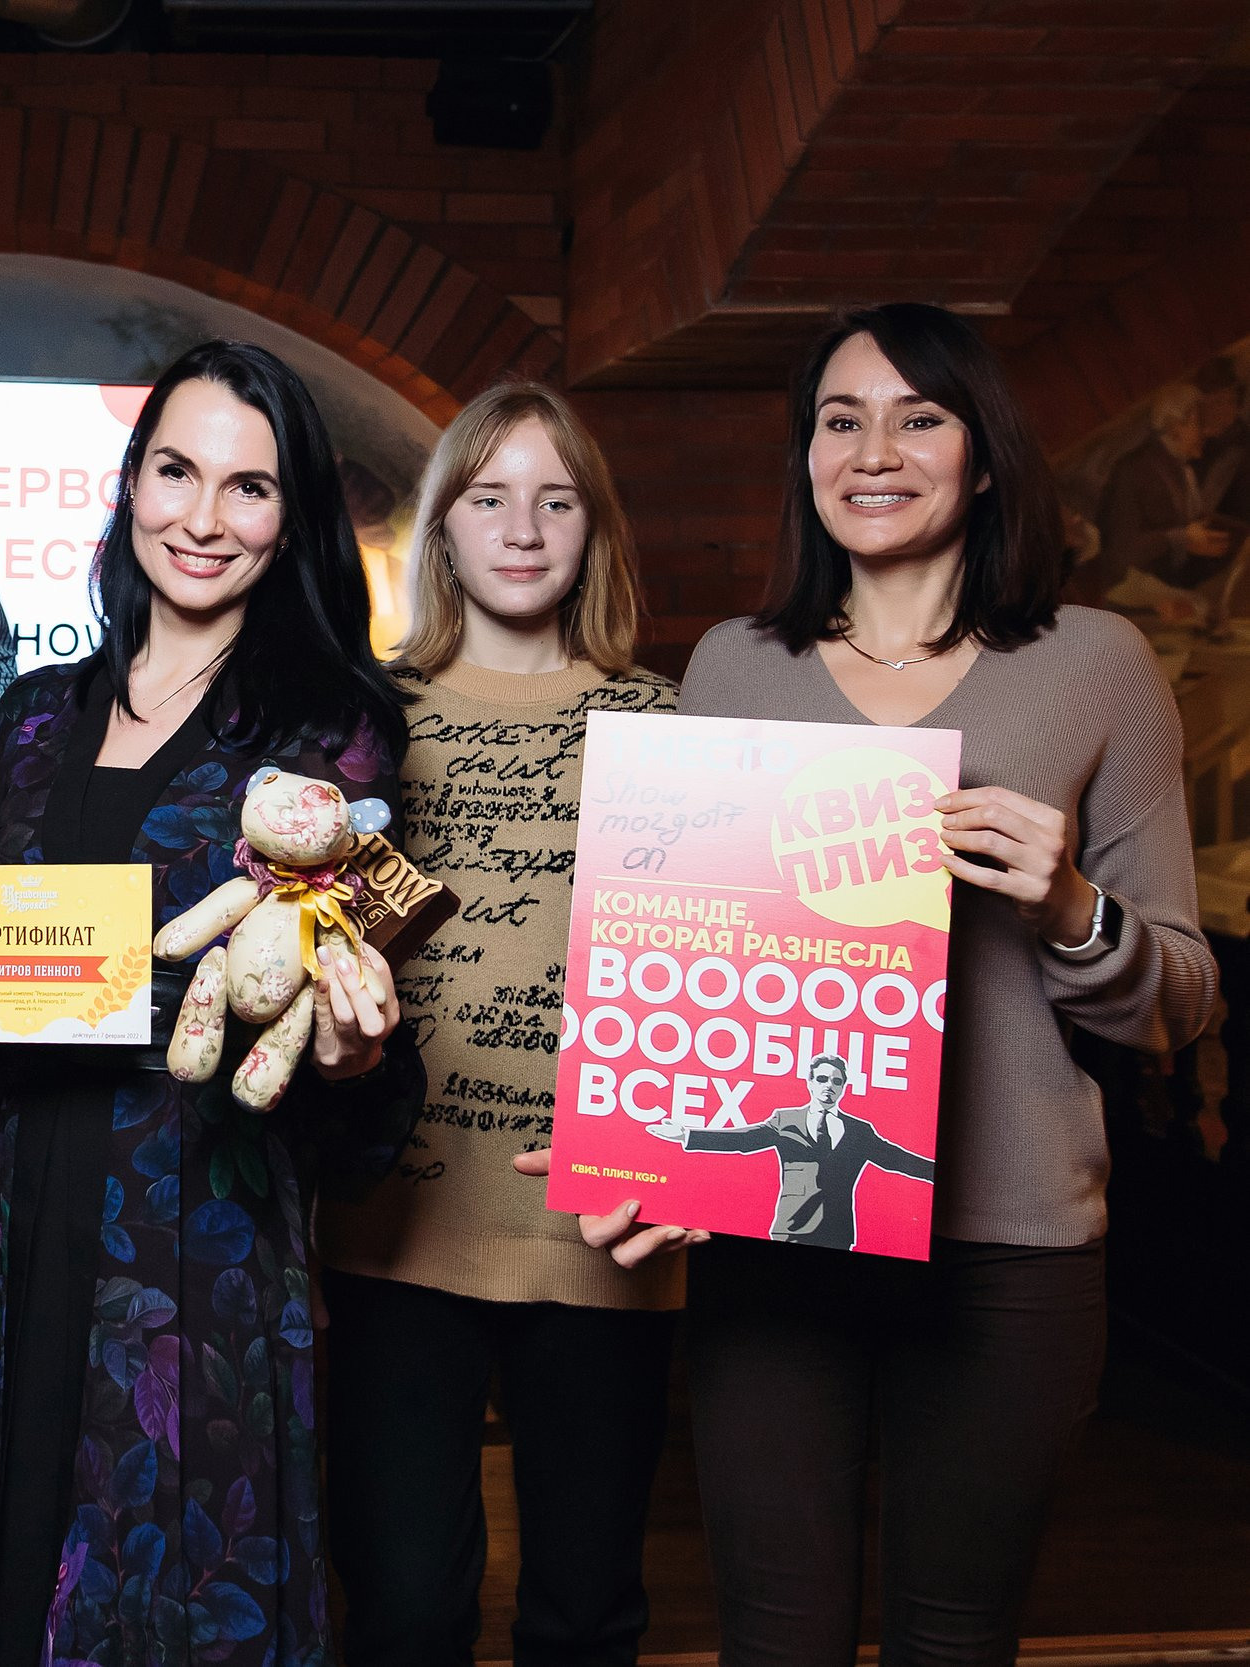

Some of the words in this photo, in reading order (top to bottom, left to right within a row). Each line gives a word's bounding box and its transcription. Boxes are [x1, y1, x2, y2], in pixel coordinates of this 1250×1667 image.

[778, 771, 936, 845] КВИЗ
[778, 826, 945, 897] ПЛИЗ
[593, 889, 755, 930] КОМАНДЕ,
[34, 965, 81, 977] ПЕННОГО
[591, 918, 733, 955] КОТОРАЯ
[743, 932, 913, 972] РАЗНЕСЛА
[577, 1062, 755, 1130] ВСЕХ
[571, 1163, 601, 1177] КВИЗ,
[603, 1167, 633, 1180] ПЛИЗ!
